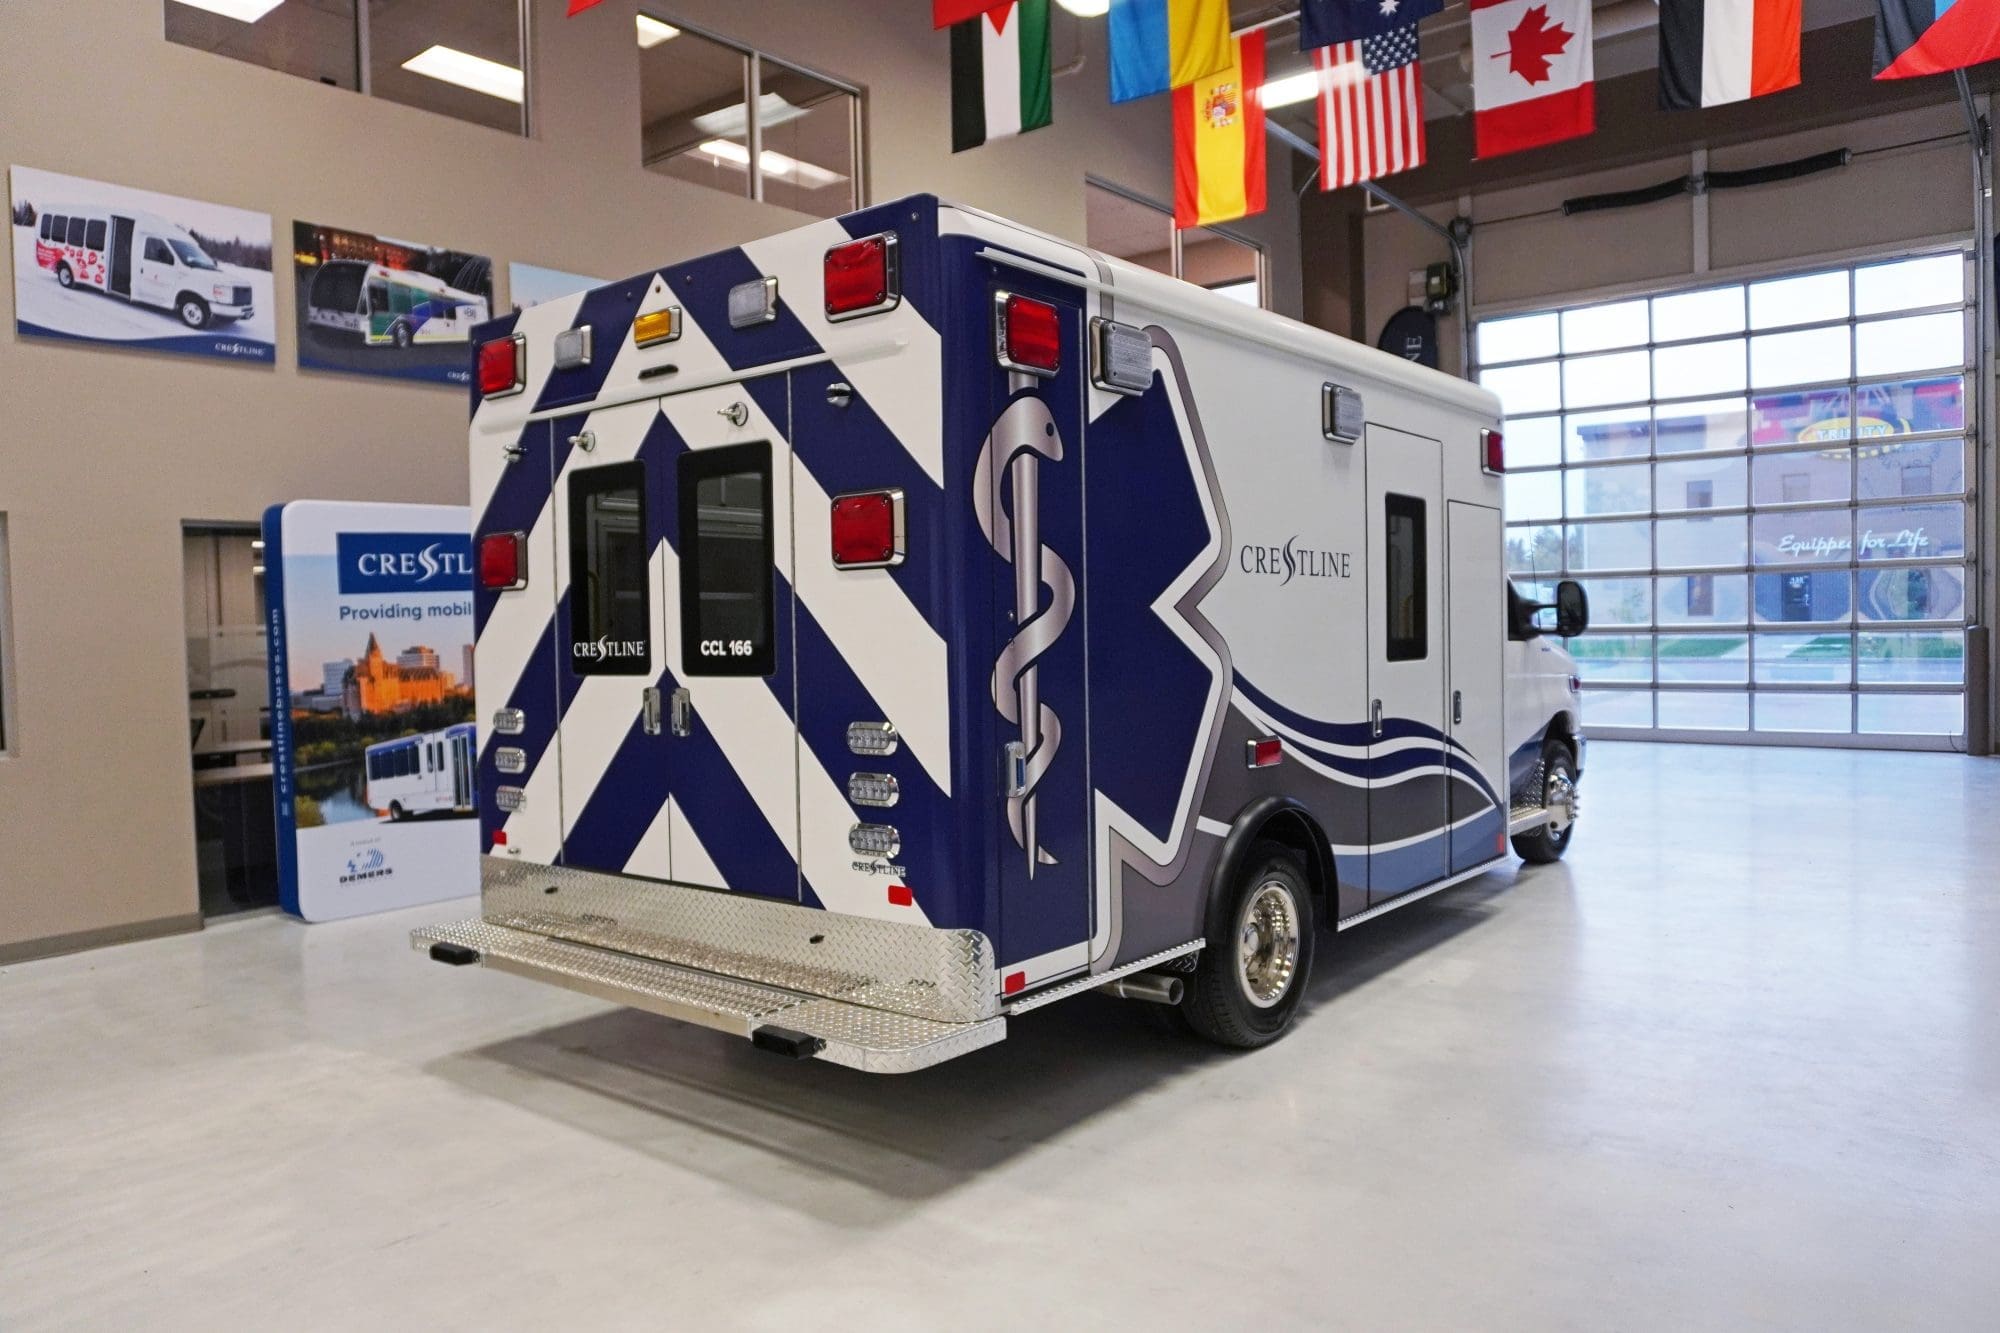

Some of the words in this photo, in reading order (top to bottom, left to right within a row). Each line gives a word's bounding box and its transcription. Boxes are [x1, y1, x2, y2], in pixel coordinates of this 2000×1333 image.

[214, 342, 265, 356] CRESTLINE
[1860, 529, 1885, 555] for
[1887, 527, 1929, 553] Life
[1240, 534, 1352, 587] CRESTLINE
[339, 603, 422, 621] Providing
[427, 602, 472, 617] mobil
[573, 634, 644, 662] CRESTLINE
[700, 640, 727, 656] CCL
[729, 639, 753, 656] 166
[272, 608, 288, 794] crestlinebuses.com
[339, 868, 393, 883] DEMERS
[851, 859, 906, 878] CRESTLINE
